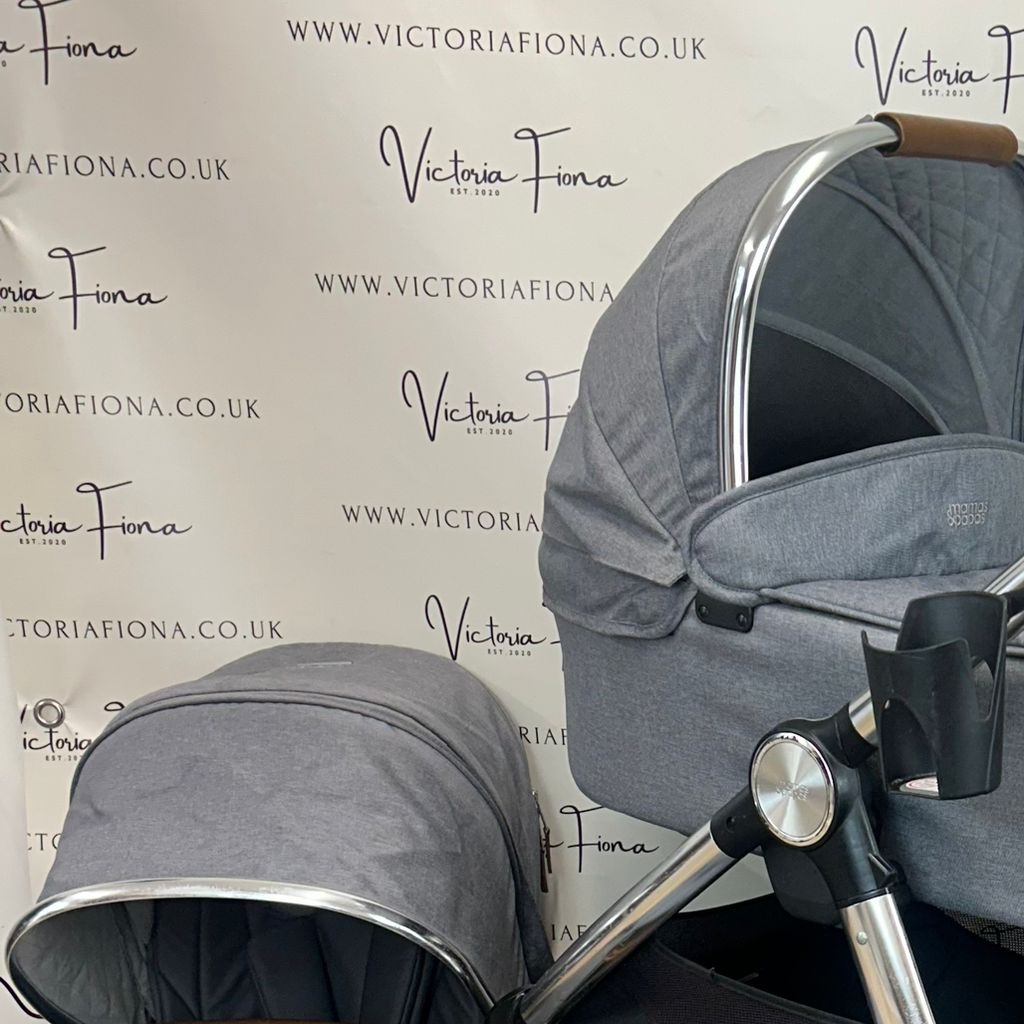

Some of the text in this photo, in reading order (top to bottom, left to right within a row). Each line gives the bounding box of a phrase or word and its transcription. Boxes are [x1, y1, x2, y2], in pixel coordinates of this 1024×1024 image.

[18, 0, 138, 86] Fiona
[285, 19, 707, 60] WWW.VICTORIAFIONA.CO.UK
[855, 25, 989, 106] Victoria
[921, 88, 971, 98] EST.2020
[0, 151, 231, 181] RIAFIONA.CO.UK
[379, 124, 628, 214] Victoria Fiona
[449, 187, 500, 197] EST.2020
[48, 245, 168, 331] Fiona
[313, 272, 615, 307] WWW.VICTORIAFIONA
[4, 391, 261, 420] ORIAFIONA.CO.UK
[401, 369, 532, 443] Victoria
[466, 427, 513, 436] EST.2020
[0, 480, 193, 560] ctoria Fiona
[341, 504, 540, 533] WWW.VICTORIA
[19, 537, 67, 546] EST.2020
[5, 617, 284, 640] TORIAFIONA.CO.UK
[425, 594, 547, 661] Victoria
[487, 648, 532, 657] EST.2020
[560, 805, 659, 872] Fiona
